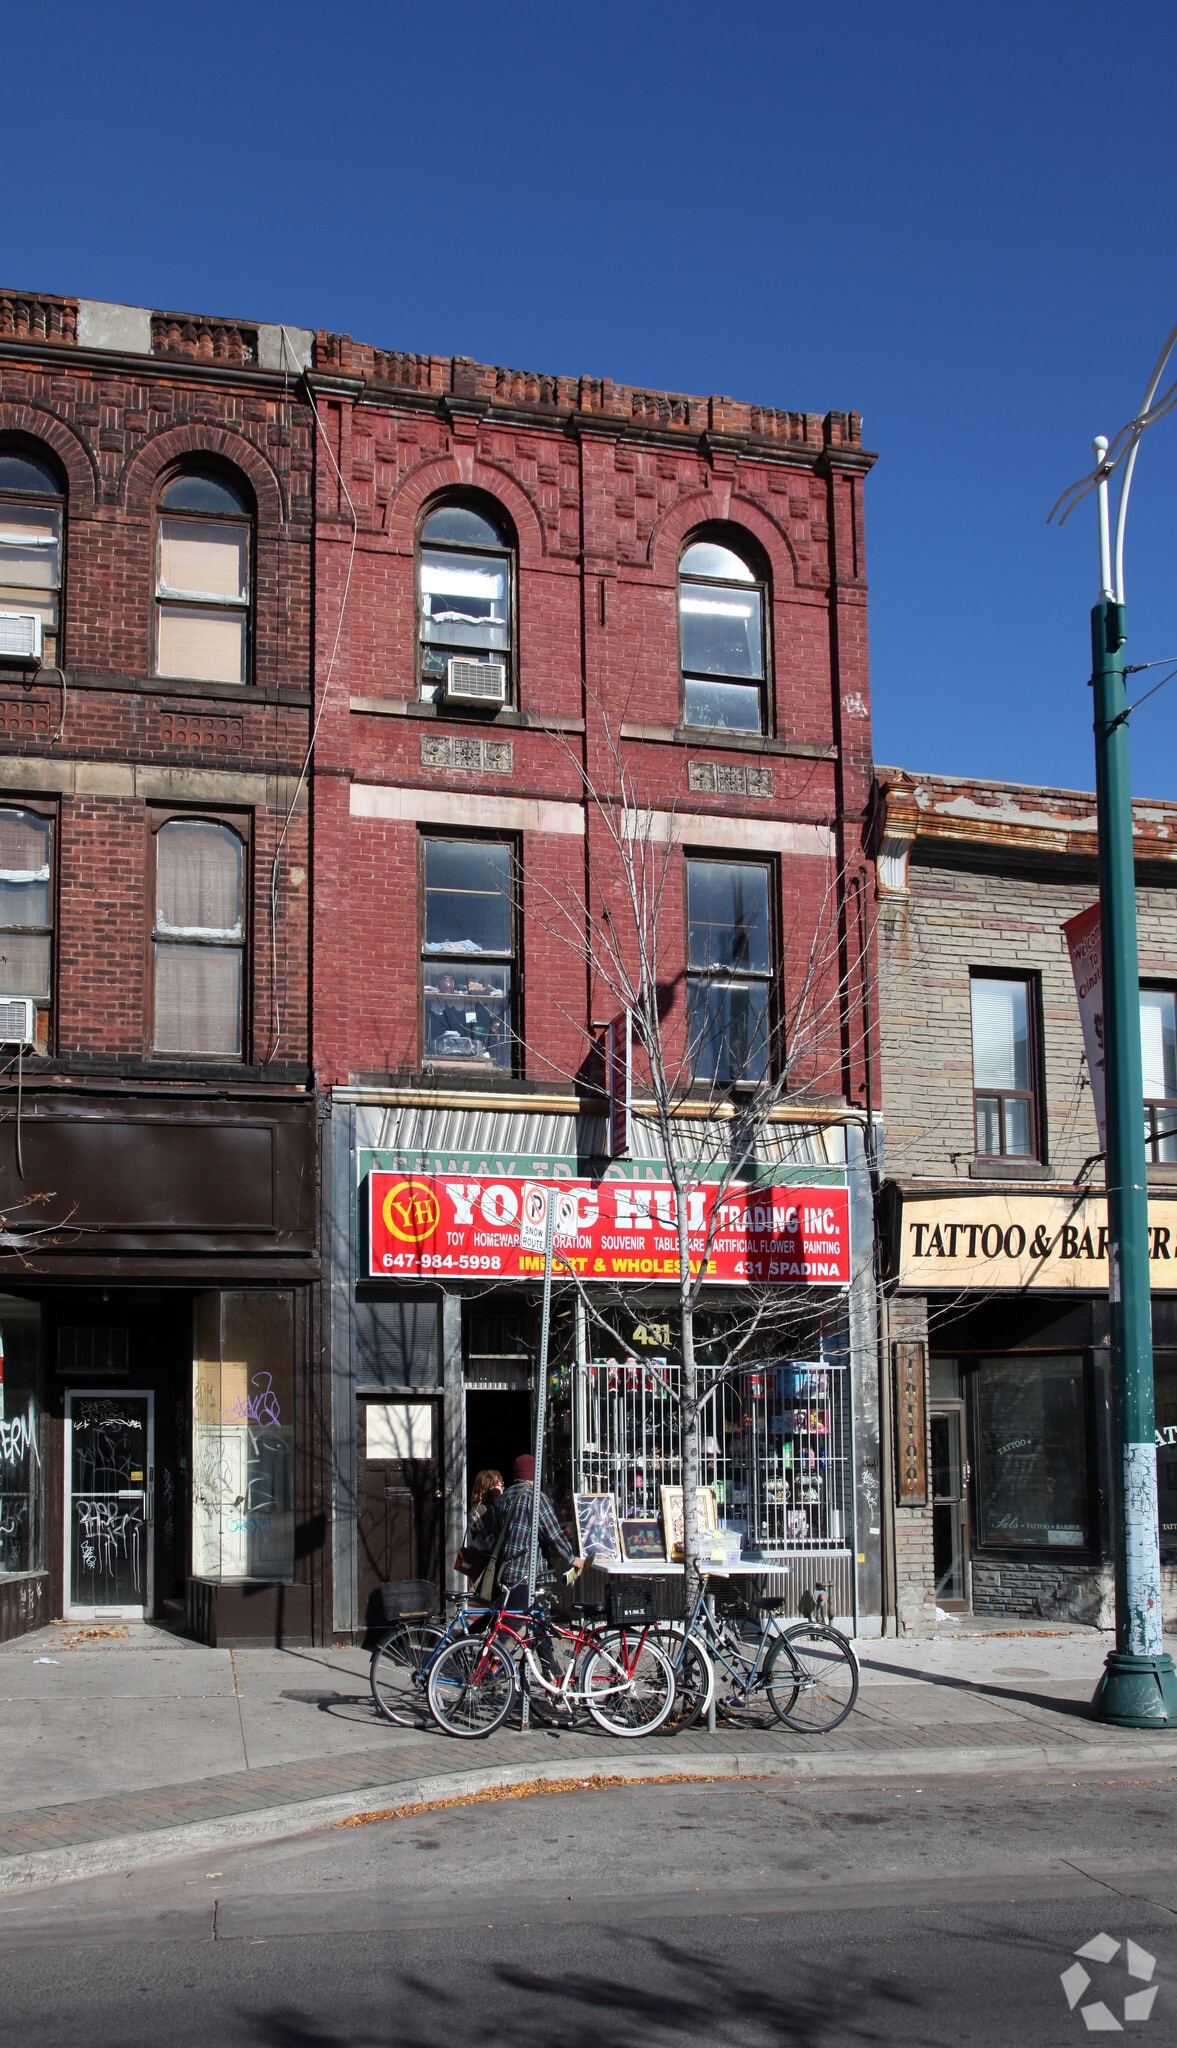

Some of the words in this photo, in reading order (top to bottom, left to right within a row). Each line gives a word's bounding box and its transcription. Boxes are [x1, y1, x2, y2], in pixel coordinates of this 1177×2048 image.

[1073, 919, 1102, 961] Welcom
[446, 1184, 600, 1230] YOG
[718, 1205, 799, 1233] TRADING
[804, 1207, 841, 1235] INC.
[523, 1236, 543, 1249] ROUTE
[525, 1226, 543, 1237] SNOW
[909, 1223, 1026, 1259] TATTOO
[1029, 1224, 1053, 1259] &
[1059, 1225, 1171, 1260] BARR
[446, 1232, 464, 1246] TOY
[474, 1232, 521, 1248] HOMEWAR
[601, 1235, 645, 1250] SOUVENIR
[654, 1237, 705, 1252] TABLEARE
[713, 1239, 758, 1252] ARTIFICIAL
[760, 1240, 795, 1254] FLOWER
[804, 1241, 841, 1255] PAINTING
[382, 1253, 502, 1270] 647-984-5998
[593, 1258, 607, 1273] &
[734, 1261, 763, 1275] 431
[770, 1262, 841, 1277] SPADINA
[633, 1324, 672, 1345] 431
[997, 1439, 1027, 1456] TATTOO
